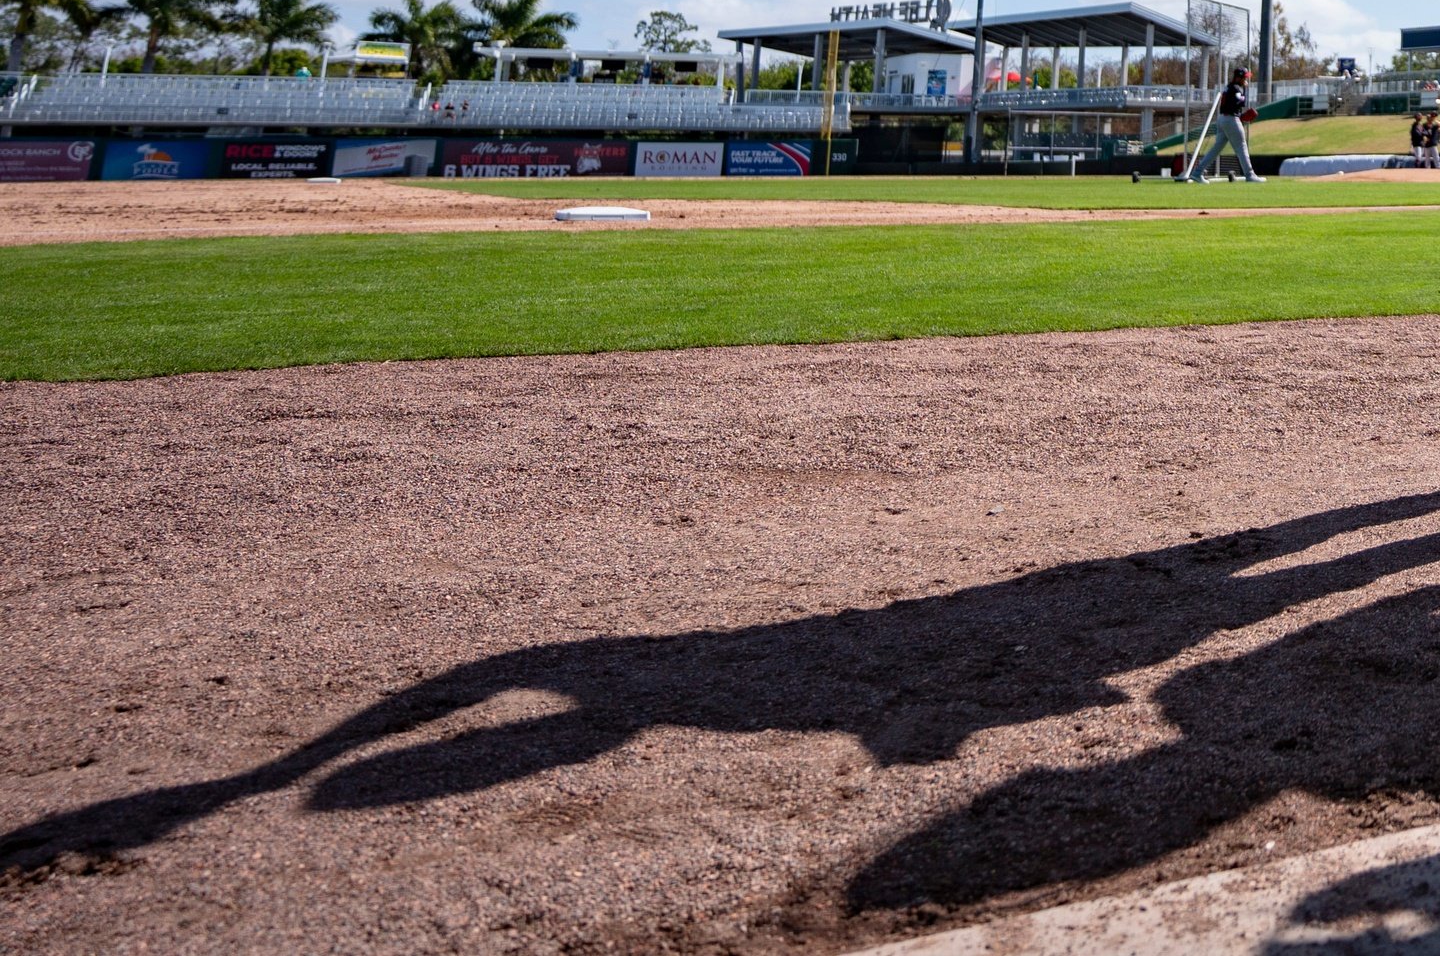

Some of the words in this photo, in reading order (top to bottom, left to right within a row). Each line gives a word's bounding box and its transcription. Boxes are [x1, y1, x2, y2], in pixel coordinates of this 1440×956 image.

[225, 144, 273, 159] RICE
[274, 144, 327, 152] WINDOWS
[643, 150, 717, 164] ROMAN
[832, 153, 847, 162] 330
[731, 156, 753, 164] YOUR
[753, 156, 784, 164] FUTURE
[444, 164, 457, 178] 6
[461, 164, 519, 178] WINGS
[525, 164, 571, 178] FREE
